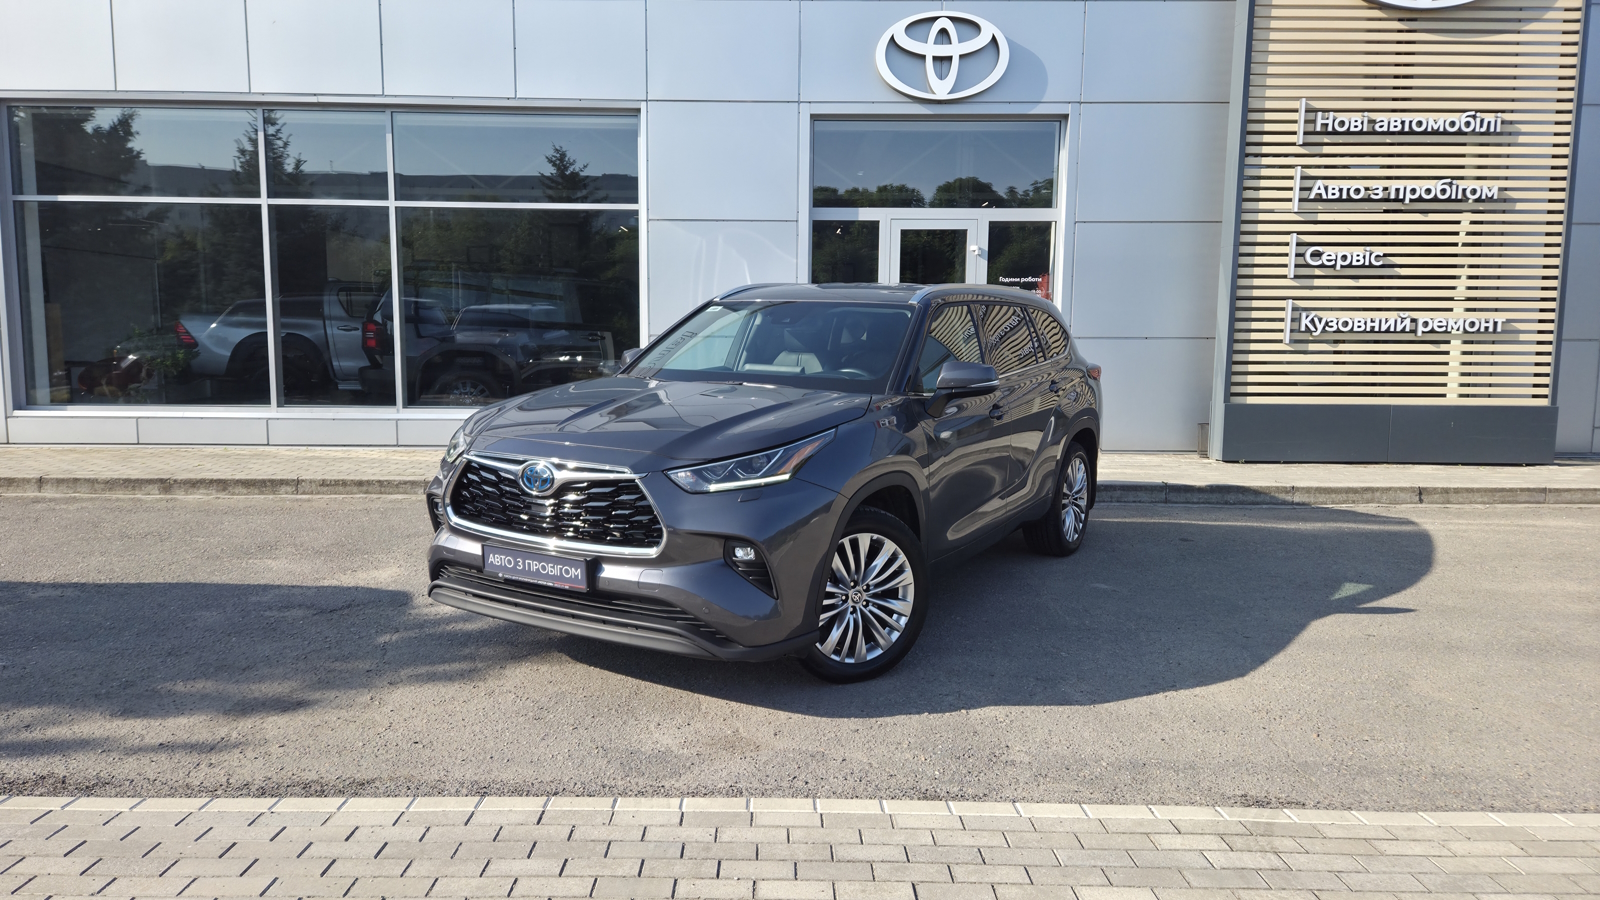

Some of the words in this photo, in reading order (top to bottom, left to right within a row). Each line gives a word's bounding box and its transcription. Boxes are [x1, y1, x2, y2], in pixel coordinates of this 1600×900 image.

[1314, 111, 1369, 133] Нові
[1374, 111, 1502, 133] автомобілі
[1308, 180, 1365, 200] Авто
[1368, 183, 1385, 200] з
[1390, 178, 1499, 204] пробігом
[1303, 246, 1384, 271] Сервіс
[1299, 312, 1411, 336] Кузовний
[1414, 316, 1507, 337] ремонт
[488, 553, 514, 568] АВТО
[516, 558, 523, 570] З
[525, 560, 581, 579] ПРОБІГОМ
